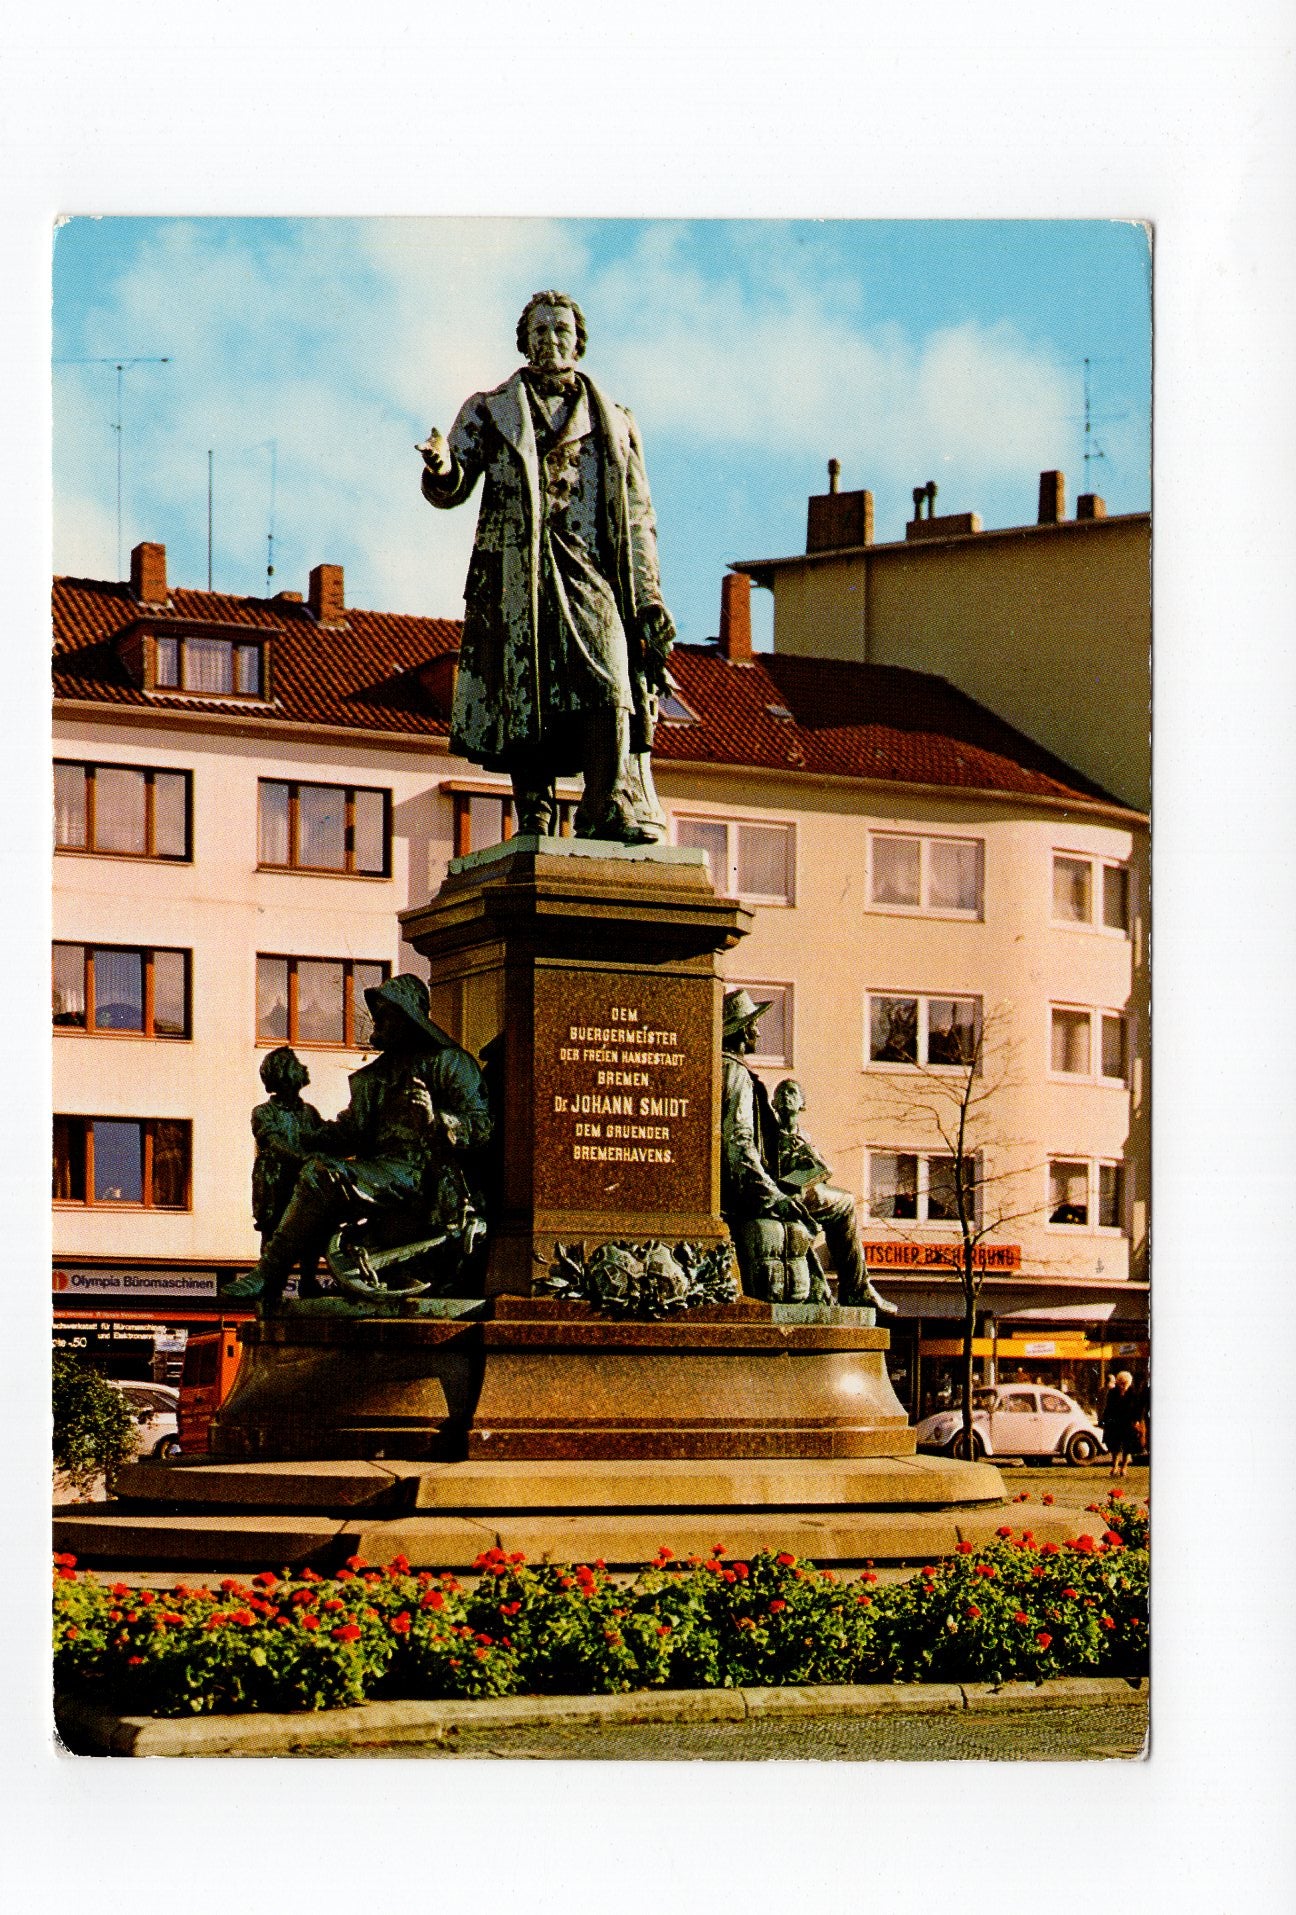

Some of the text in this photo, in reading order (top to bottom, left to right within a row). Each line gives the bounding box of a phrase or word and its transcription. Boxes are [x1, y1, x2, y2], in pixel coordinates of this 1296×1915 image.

[611, 1007, 638, 1022] DEM
[570, 1025, 677, 1046] BUERGERMEISTER
[560, 1045, 685, 1066] DER FREIEN HANSESTADT
[597, 1071, 649, 1086] BREMEN
[571, 1094, 633, 1115] JOHANN
[639, 1097, 690, 1117] SMIDT
[575, 1123, 670, 1140] DEM GRUENDER
[573, 1145, 675, 1163] BREMERHAVENS.
[71, 1274, 214, 1289] Olympia Büromaschinen
